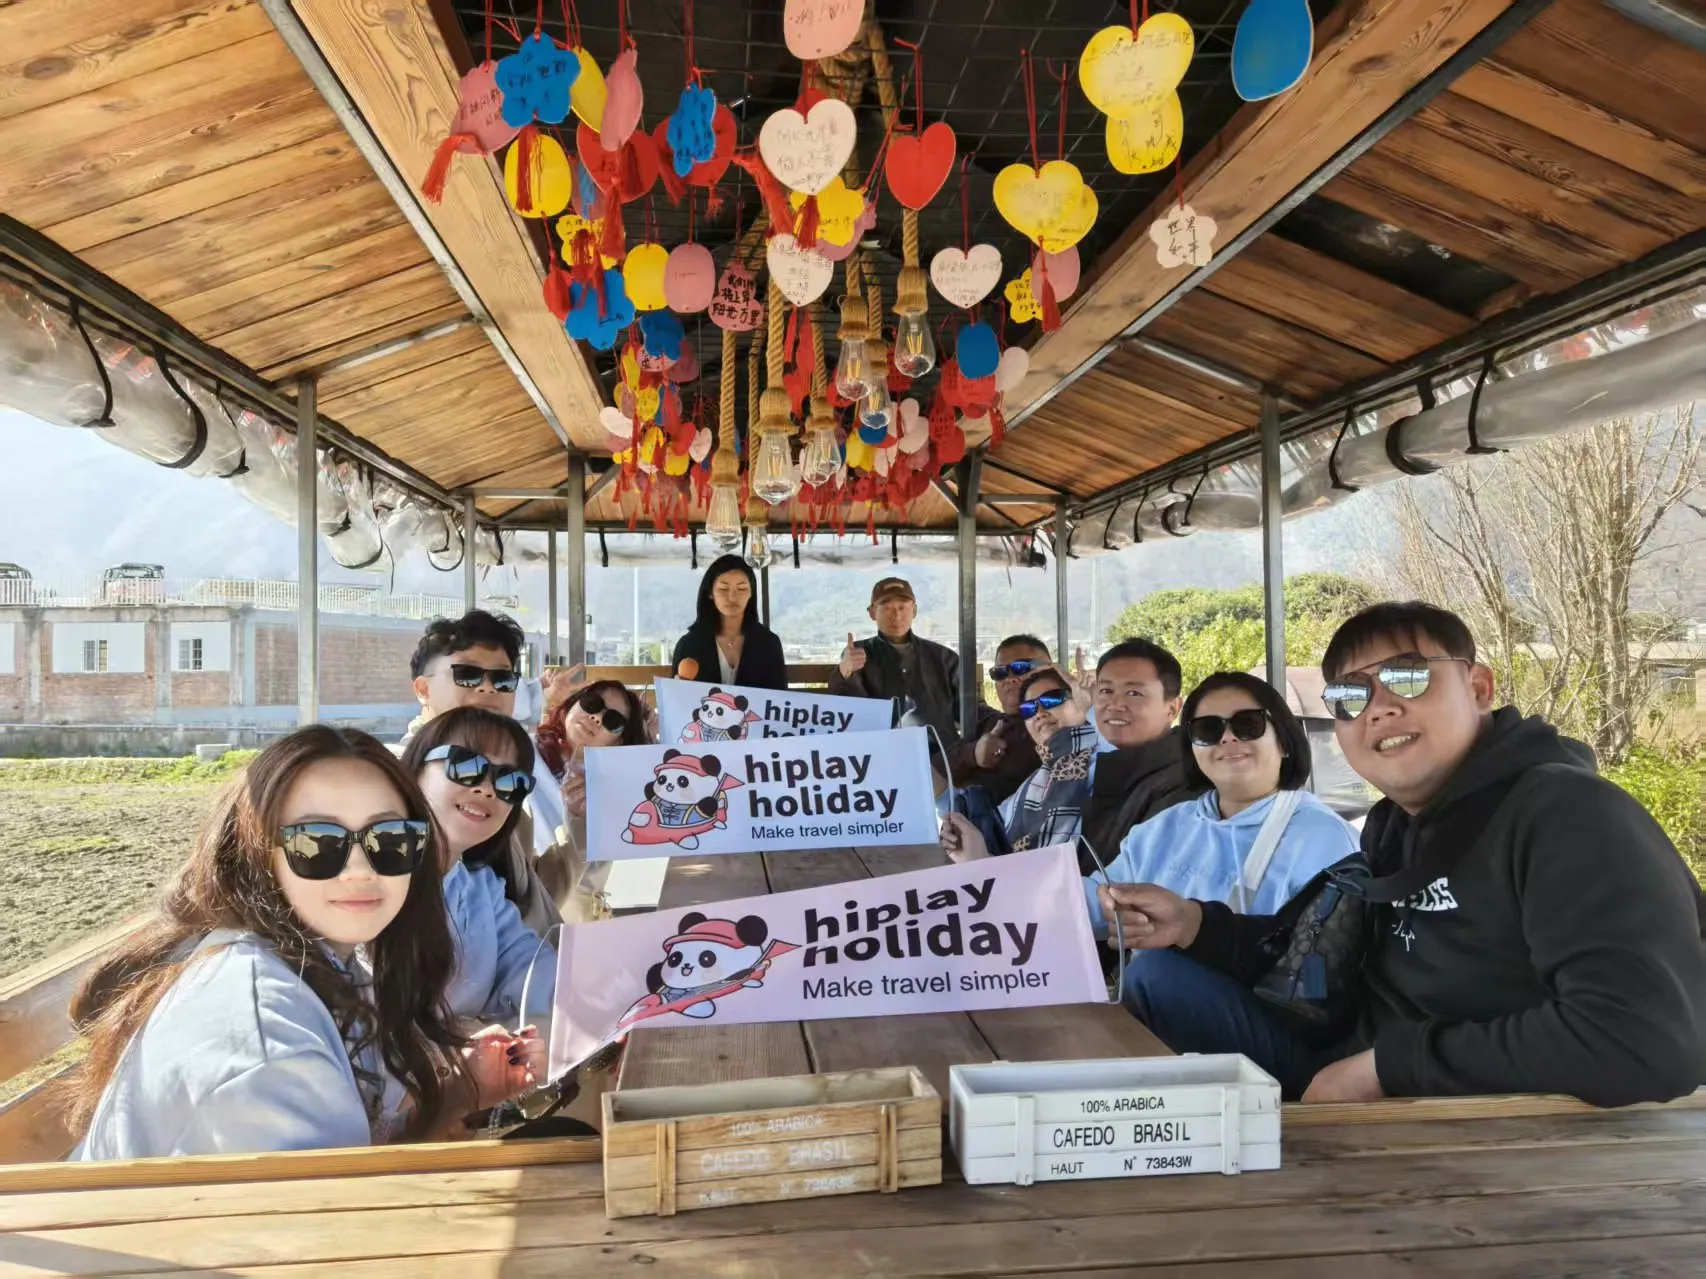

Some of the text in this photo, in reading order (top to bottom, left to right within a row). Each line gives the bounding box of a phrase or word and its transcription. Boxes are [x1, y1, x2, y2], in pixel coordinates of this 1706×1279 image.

[764, 699, 854, 733] hiplay
[744, 750, 872, 789] hiplay
[748, 784, 898, 819] holiday
[751, 820, 904, 840] Make travel simpler
[804, 877, 996, 945] hiplay
[802, 967, 1051, 1000] Make travel simpler
[1080, 1096, 1165, 1113] 100% ARABICA
[1053, 1122, 1191, 1148] CAFEDO BRASIL
[1051, 1161, 1084, 1176] HAUT
[1145, 1155, 1193, 1170] 73843W
